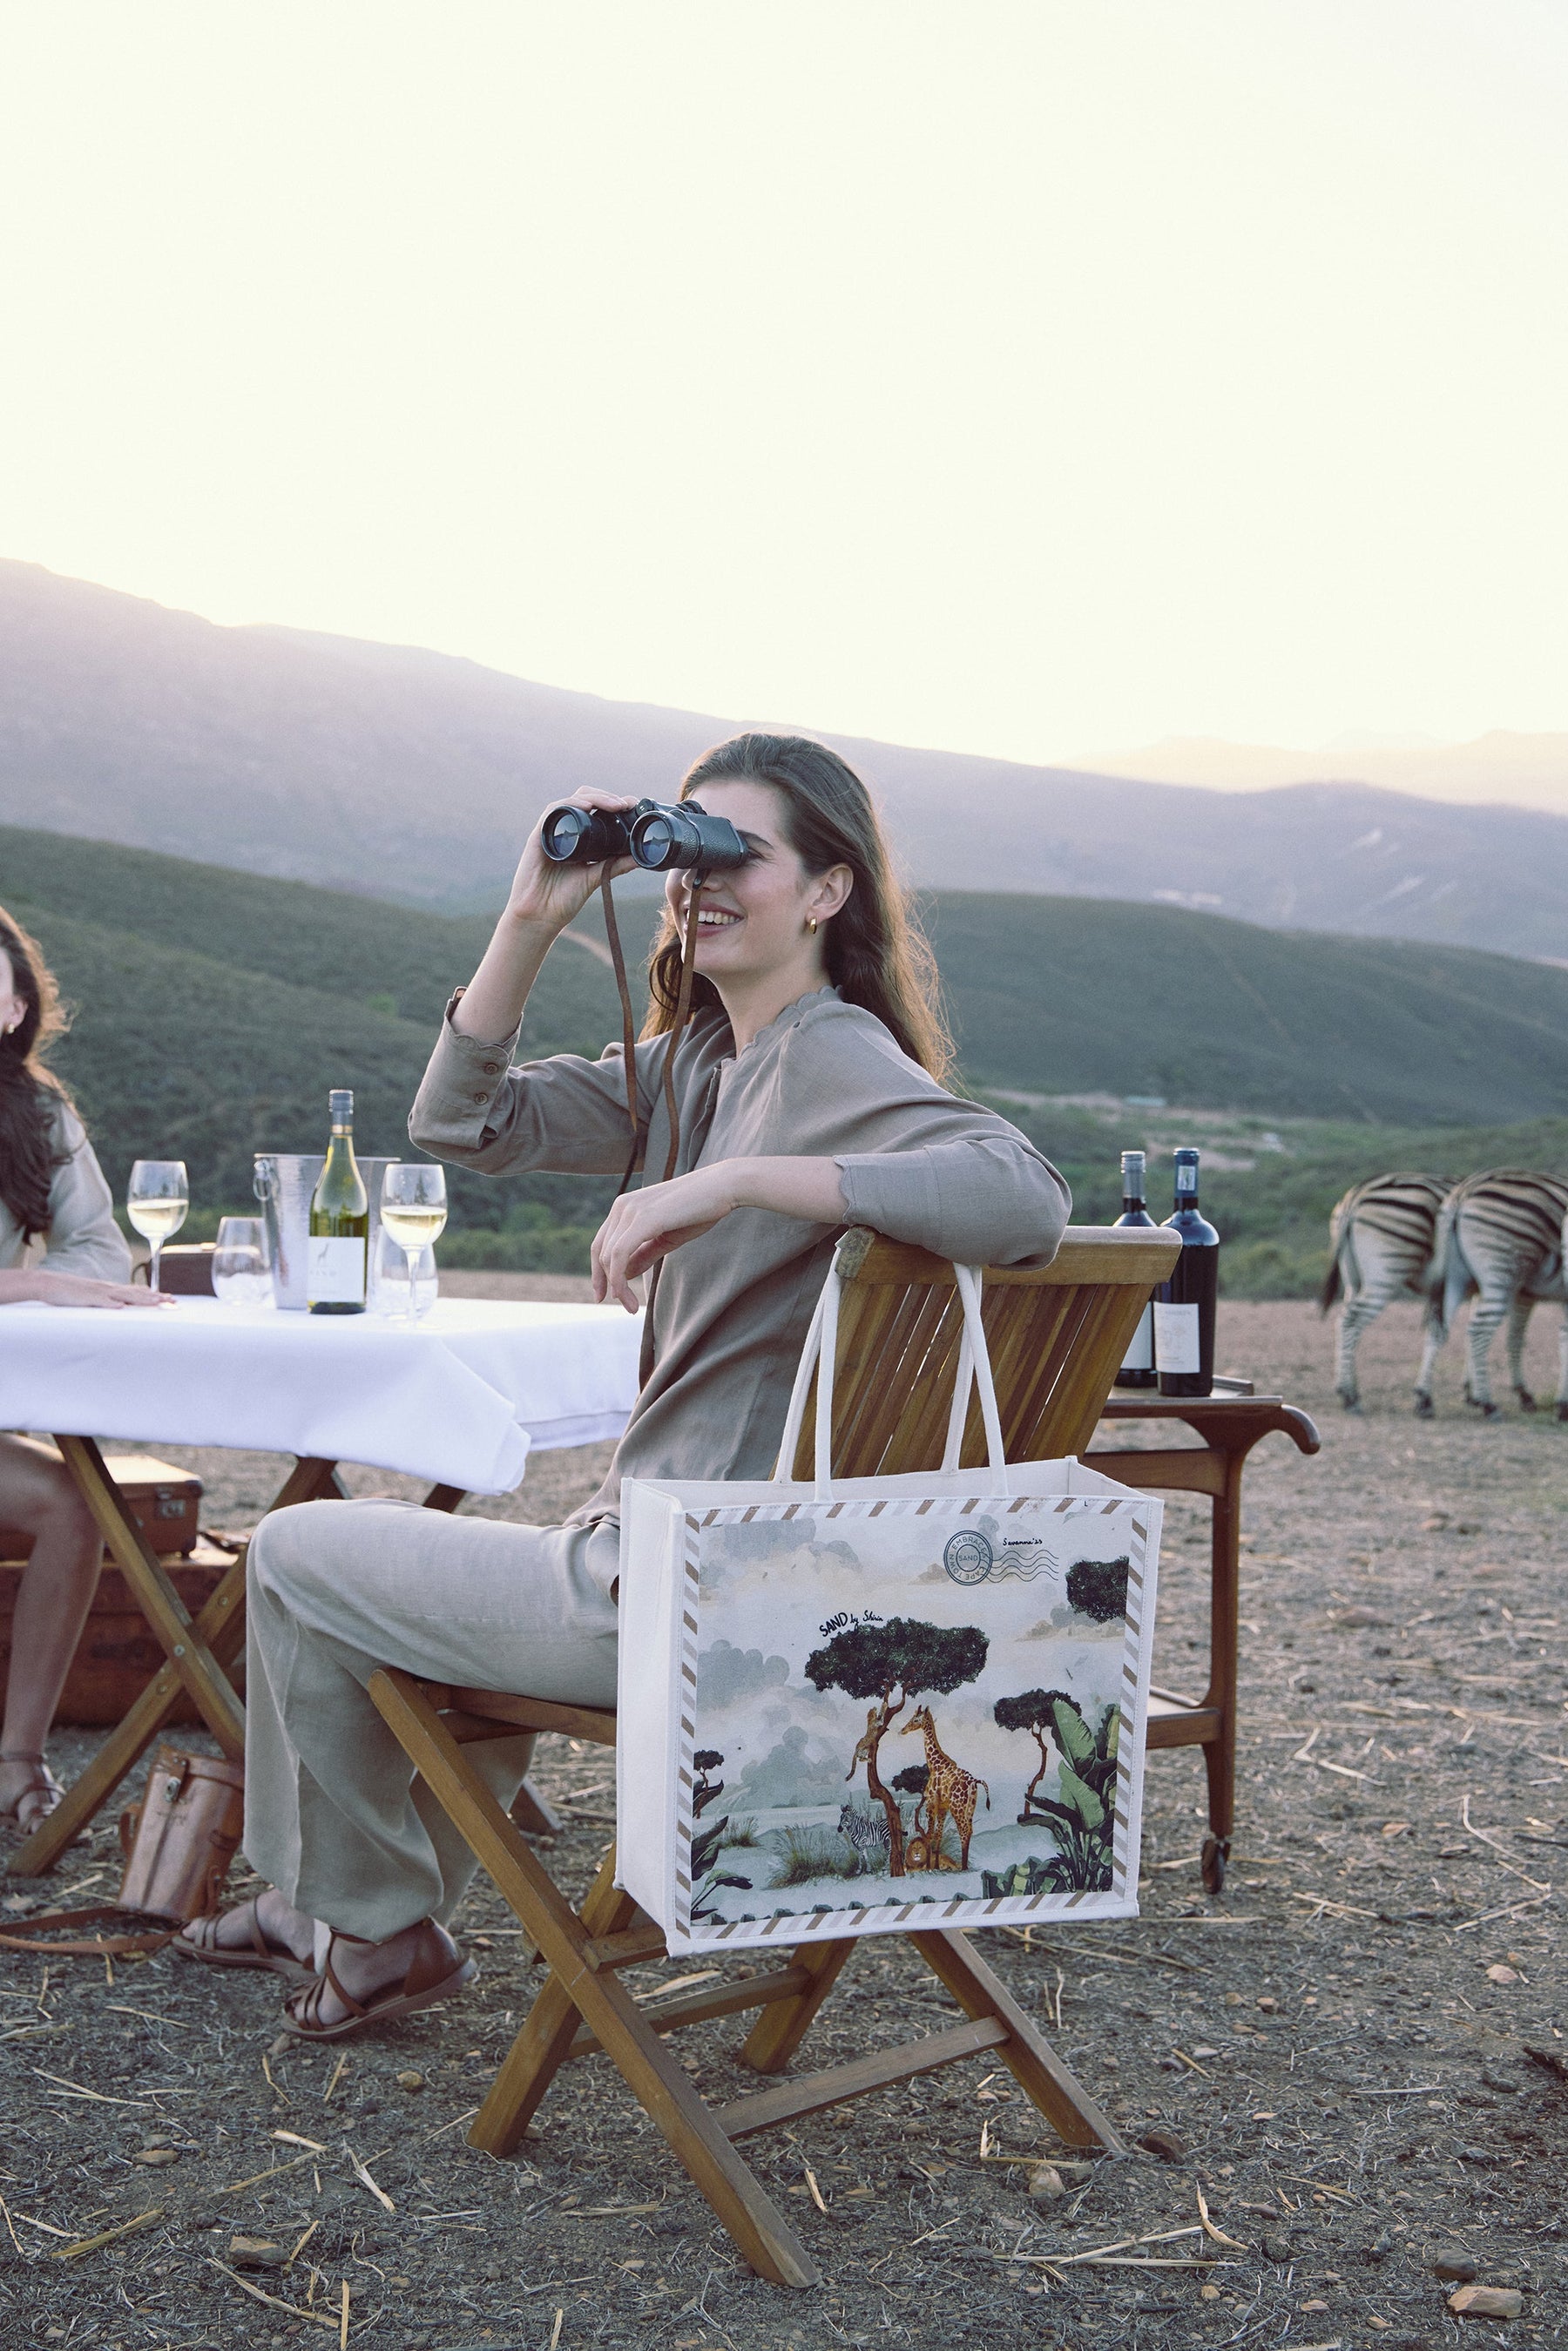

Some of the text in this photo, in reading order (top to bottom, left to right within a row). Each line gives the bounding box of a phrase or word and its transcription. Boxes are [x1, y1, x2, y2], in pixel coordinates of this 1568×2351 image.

[951, 1536, 987, 1558] EMBRACES
[950, 1554, 985, 1580] CAPE TOWN
[819, 1611, 848, 1638] SAND
[849, 1613, 860, 1632] by
